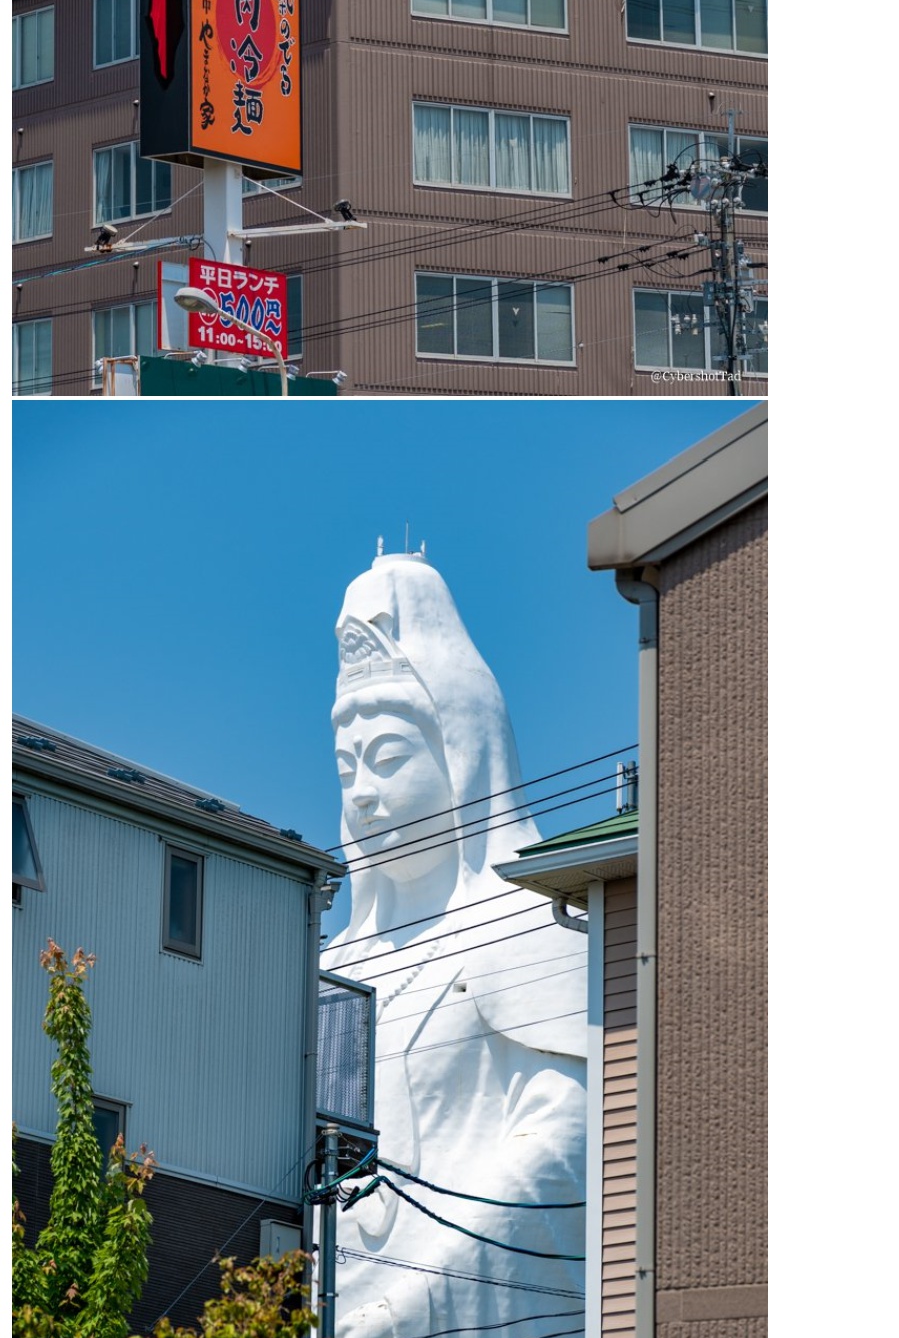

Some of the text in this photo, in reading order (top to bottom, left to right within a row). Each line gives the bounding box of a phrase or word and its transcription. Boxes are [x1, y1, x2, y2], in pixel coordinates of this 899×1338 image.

[200, 265, 280, 295] 平日ランチ
